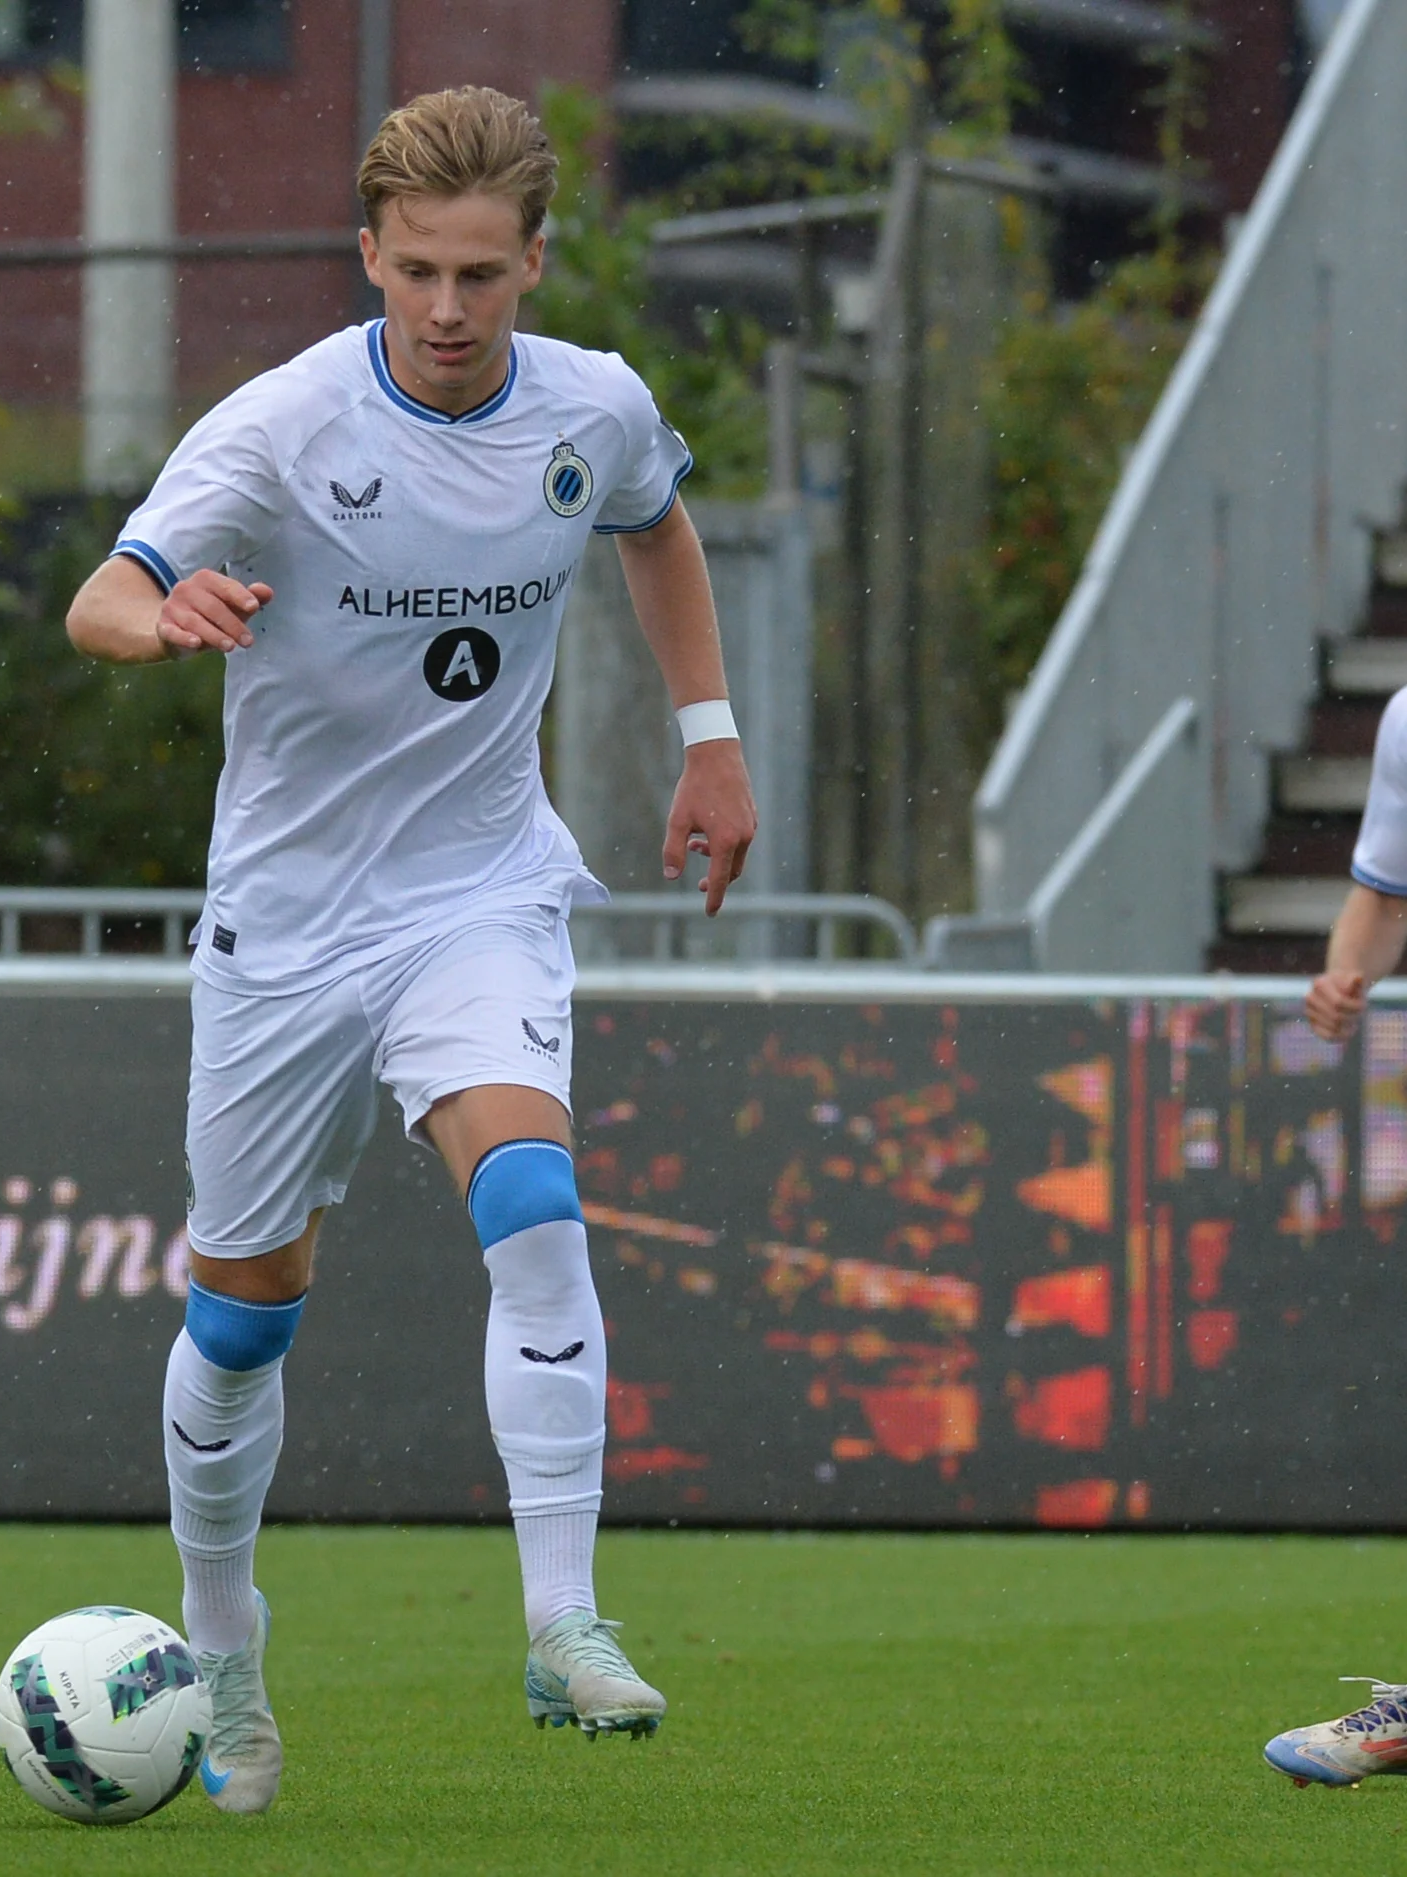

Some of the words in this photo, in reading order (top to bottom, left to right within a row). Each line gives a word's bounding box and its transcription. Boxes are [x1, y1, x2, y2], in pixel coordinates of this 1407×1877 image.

[333, 511, 383, 521] CASTORE
[441, 640, 481, 687] A
[59, 1671, 80, 1709] KIPSTA
